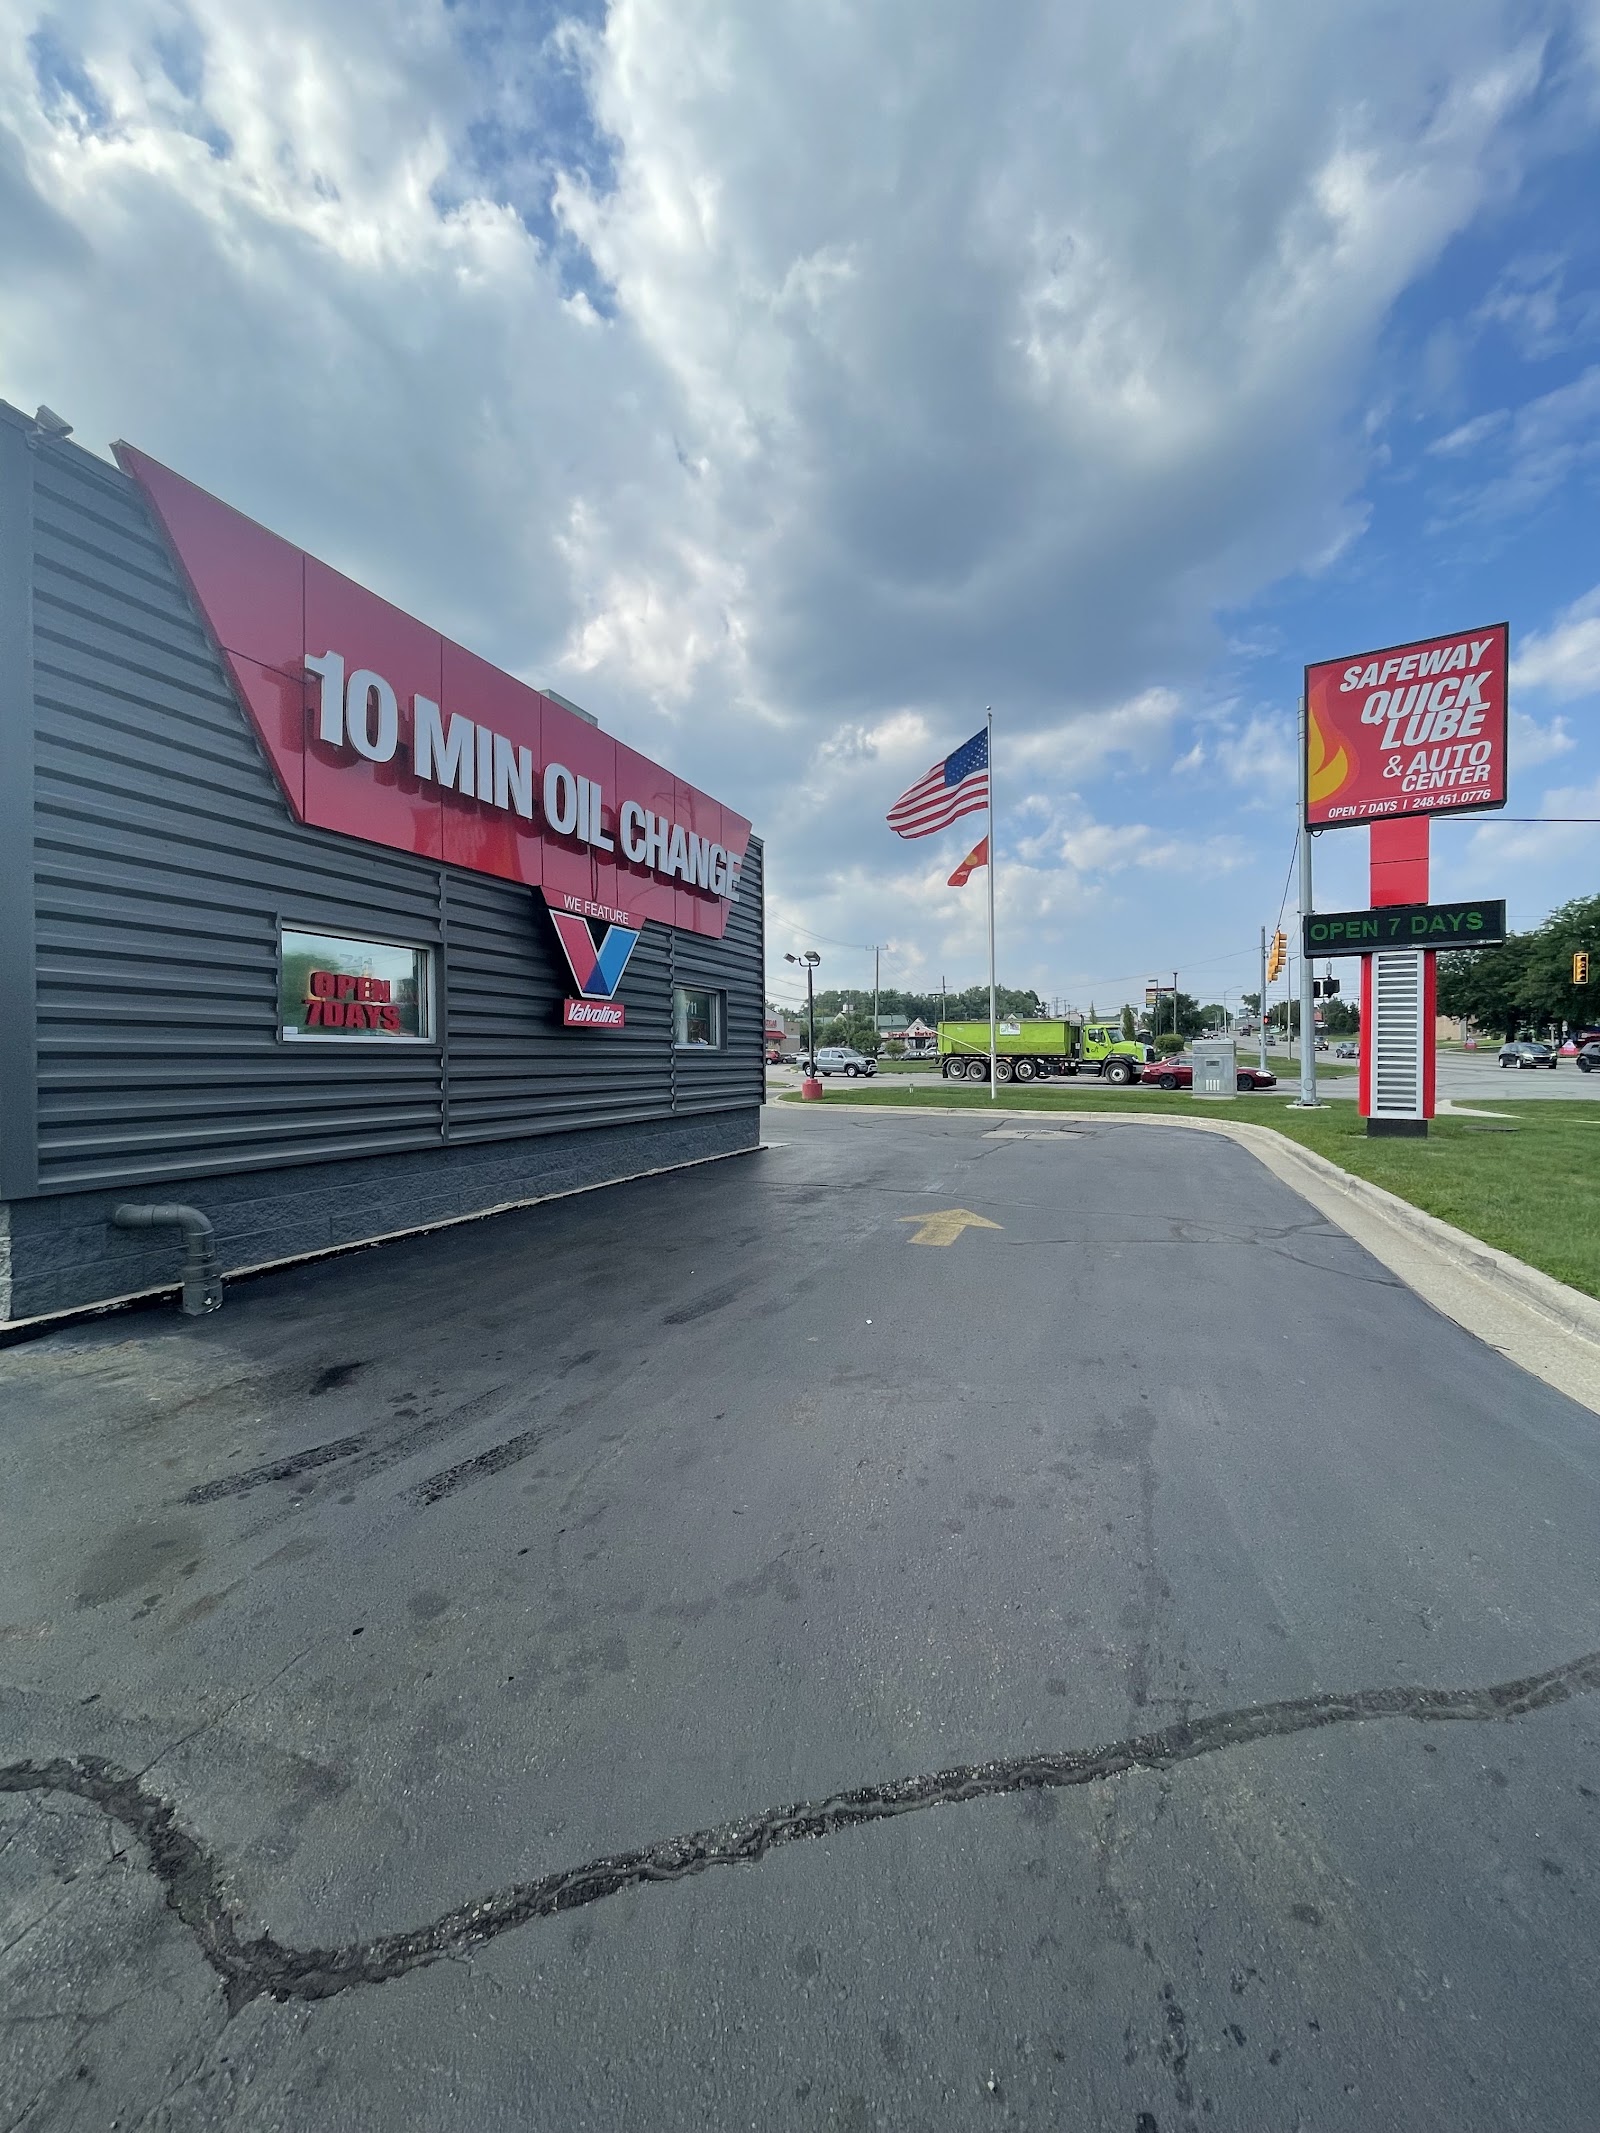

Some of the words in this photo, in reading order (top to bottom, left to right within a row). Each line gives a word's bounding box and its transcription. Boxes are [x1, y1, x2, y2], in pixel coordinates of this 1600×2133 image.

[1339, 638, 1495, 692] SAFEWAY
[1360, 671, 1493, 726] QUICK
[1380, 702, 1491, 750] LUBE
[1382, 755, 1402, 779] &
[1409, 740, 1492, 775] AUTO
[304, 650, 399, 763] 10
[414, 693, 533, 819] MIN
[543, 762, 615, 852] OIL
[619, 800, 743, 902] CHANGE
[1401, 765, 1491, 792] CENTER
[1328, 806, 1356, 819] OPEN
[1359, 804, 1366, 815] 7
[1368, 800, 1397, 814] DAYS
[1412, 789, 1491, 809] 248.451.0776
[563, 894, 582, 913] WE
[584, 901, 629, 925] FEATURE
[1310, 918, 1379, 941] OPEN
[1389, 917, 1402, 936] 7
[1411, 911, 1484, 935] DAYS
[310, 971, 391, 1003] OPEN
[567, 1002, 622, 1024] Valvoline
